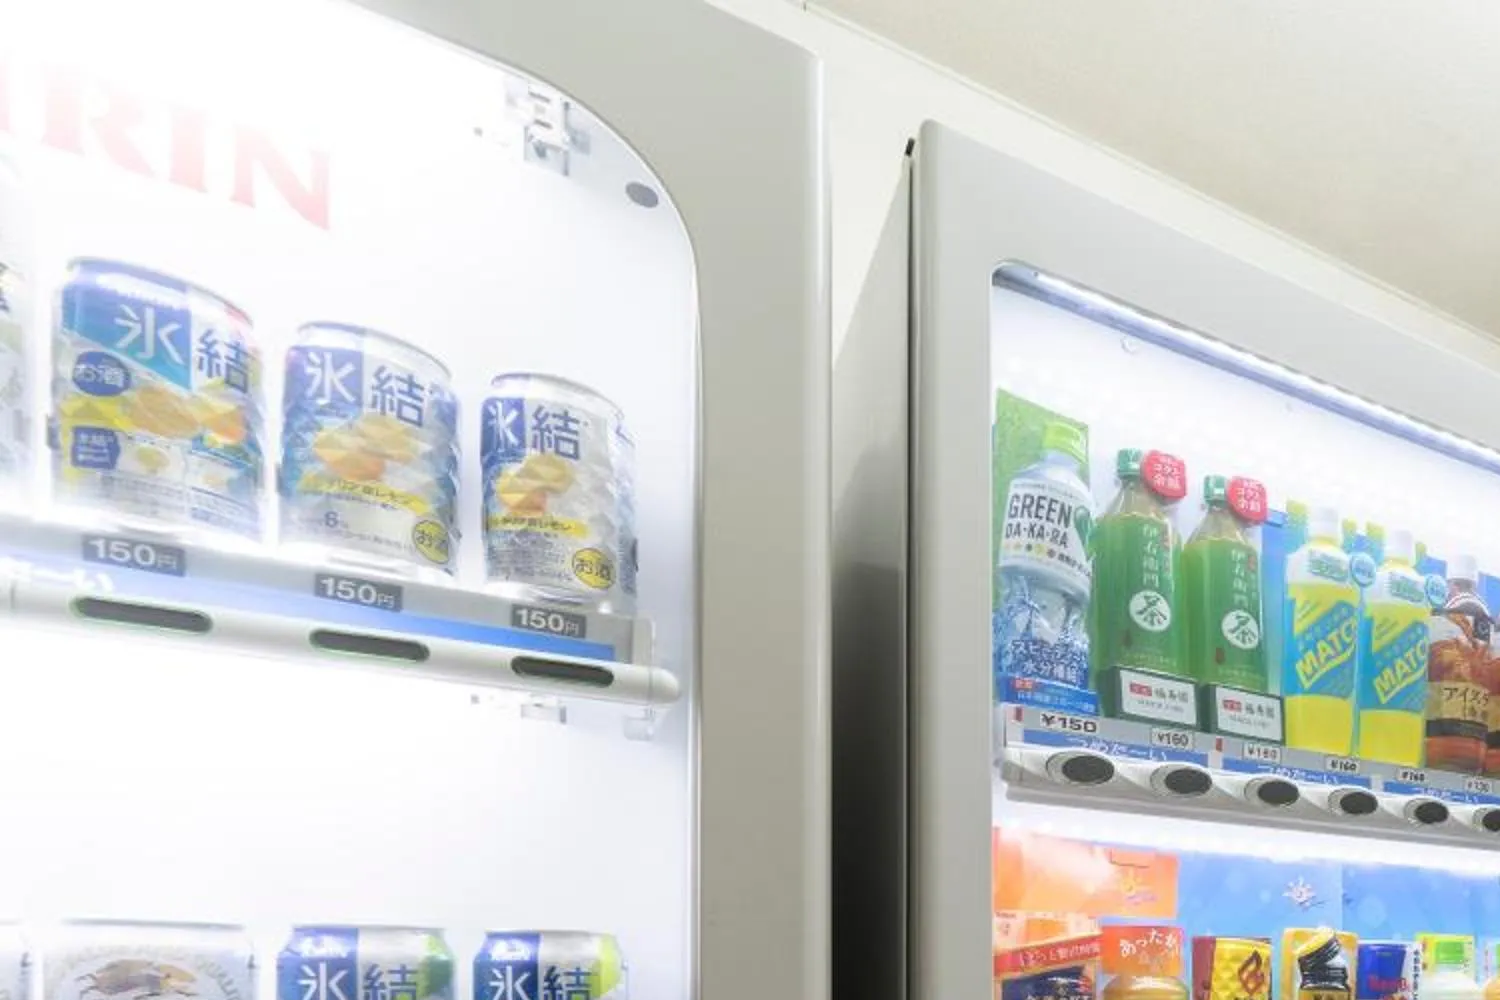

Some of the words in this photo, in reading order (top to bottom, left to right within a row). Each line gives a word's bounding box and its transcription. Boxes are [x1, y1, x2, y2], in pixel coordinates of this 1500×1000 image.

[113, 304, 250, 394] 氷結
[304, 351, 425, 427] 氷結
[487, 400, 581, 460] 氷結
[1008, 493, 1073, 527] GREEN
[88, 537, 178, 570] 150円
[320, 577, 396, 608] 150円
[515, 608, 580, 636] 150円
[1042, 713, 1097, 733] ¥150
[1157, 732, 1189, 746] ¥160
